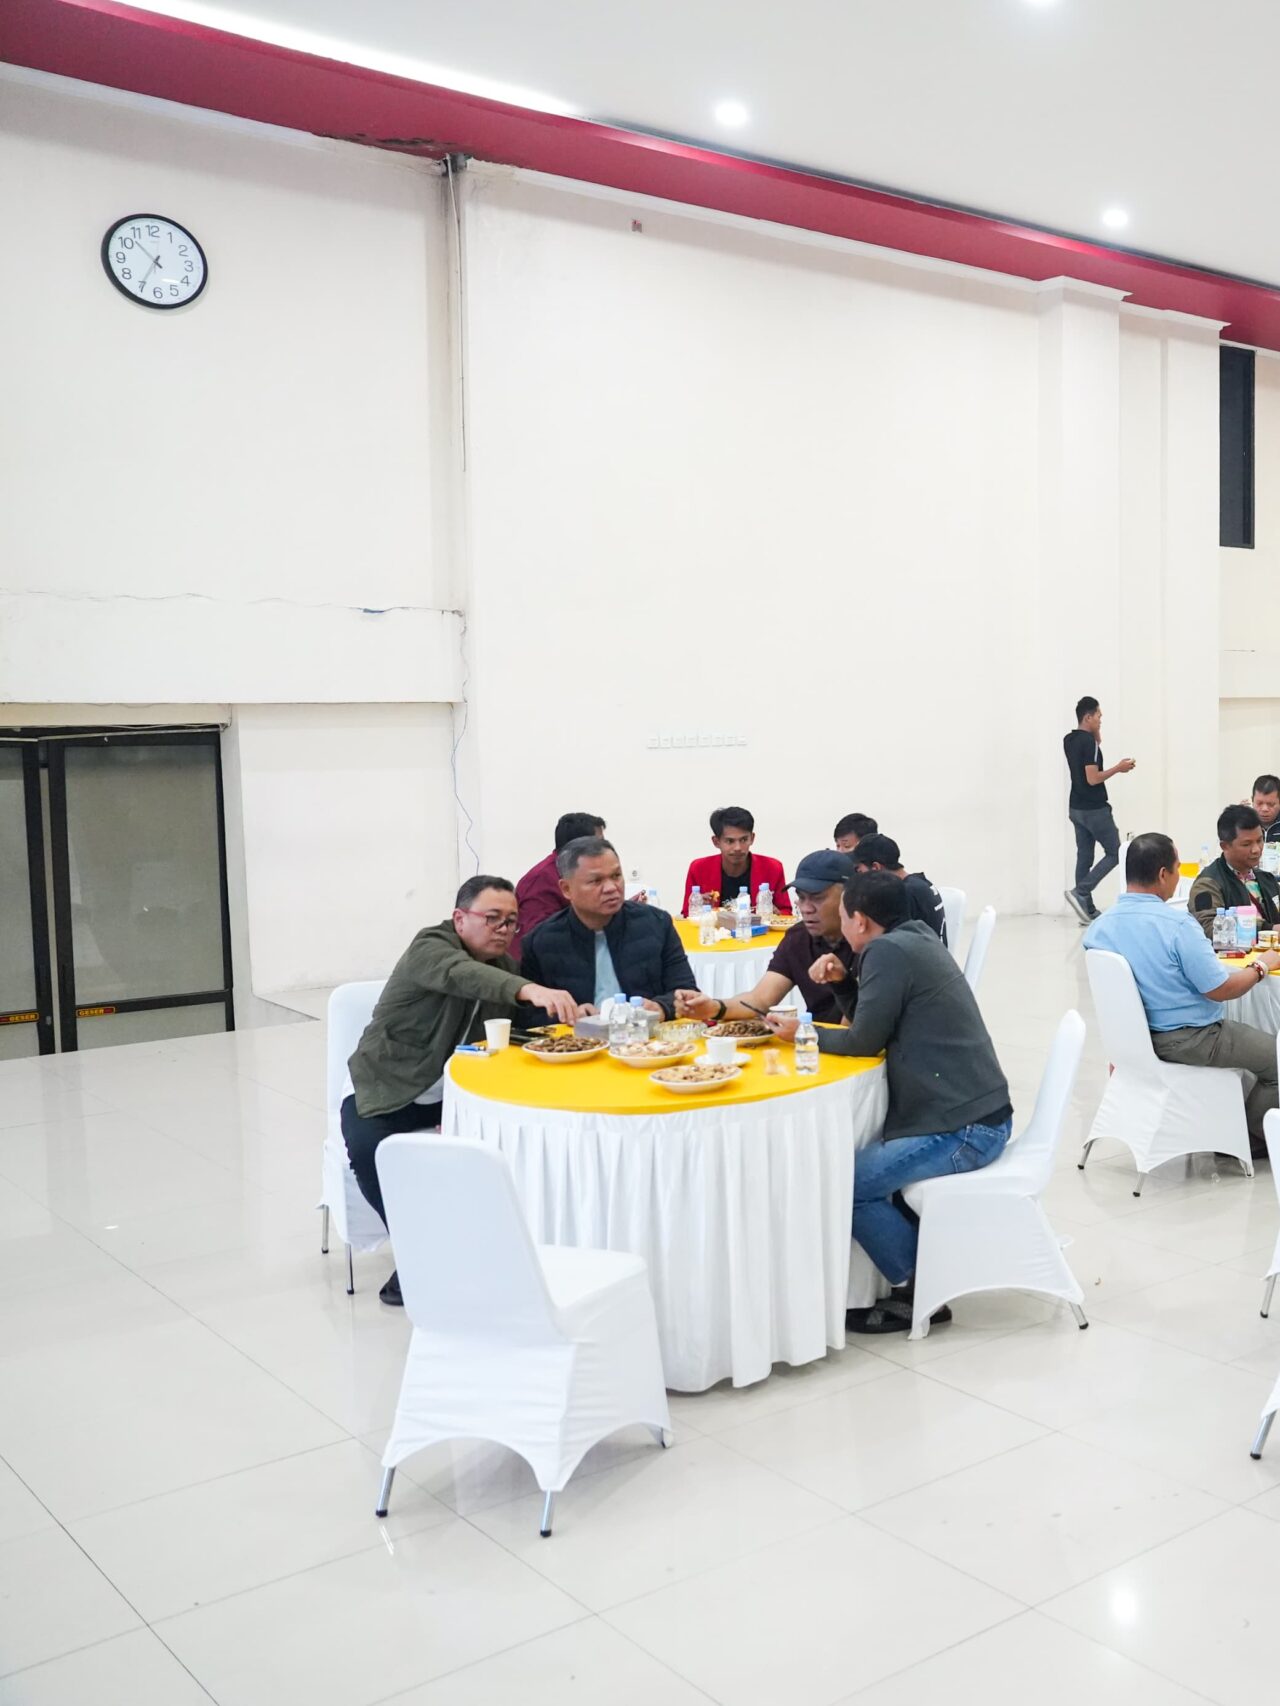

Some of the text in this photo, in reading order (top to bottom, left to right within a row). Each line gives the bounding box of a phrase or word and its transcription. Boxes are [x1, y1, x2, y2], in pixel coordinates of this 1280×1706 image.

[131, 226, 142, 239] 11
[145, 225, 161, 238] 12
[167, 232, 173, 243] 1
[118, 236, 134, 249] 10
[115, 251, 126, 264] 9
[178, 245, 188, 257] 2
[184, 260, 194, 272] 3
[121, 267, 132, 280] 8
[138, 280, 147, 293] 7
[180, 275, 190, 287] 4
[153, 286, 163, 299] 6
[169, 284, 179, 297] 5
